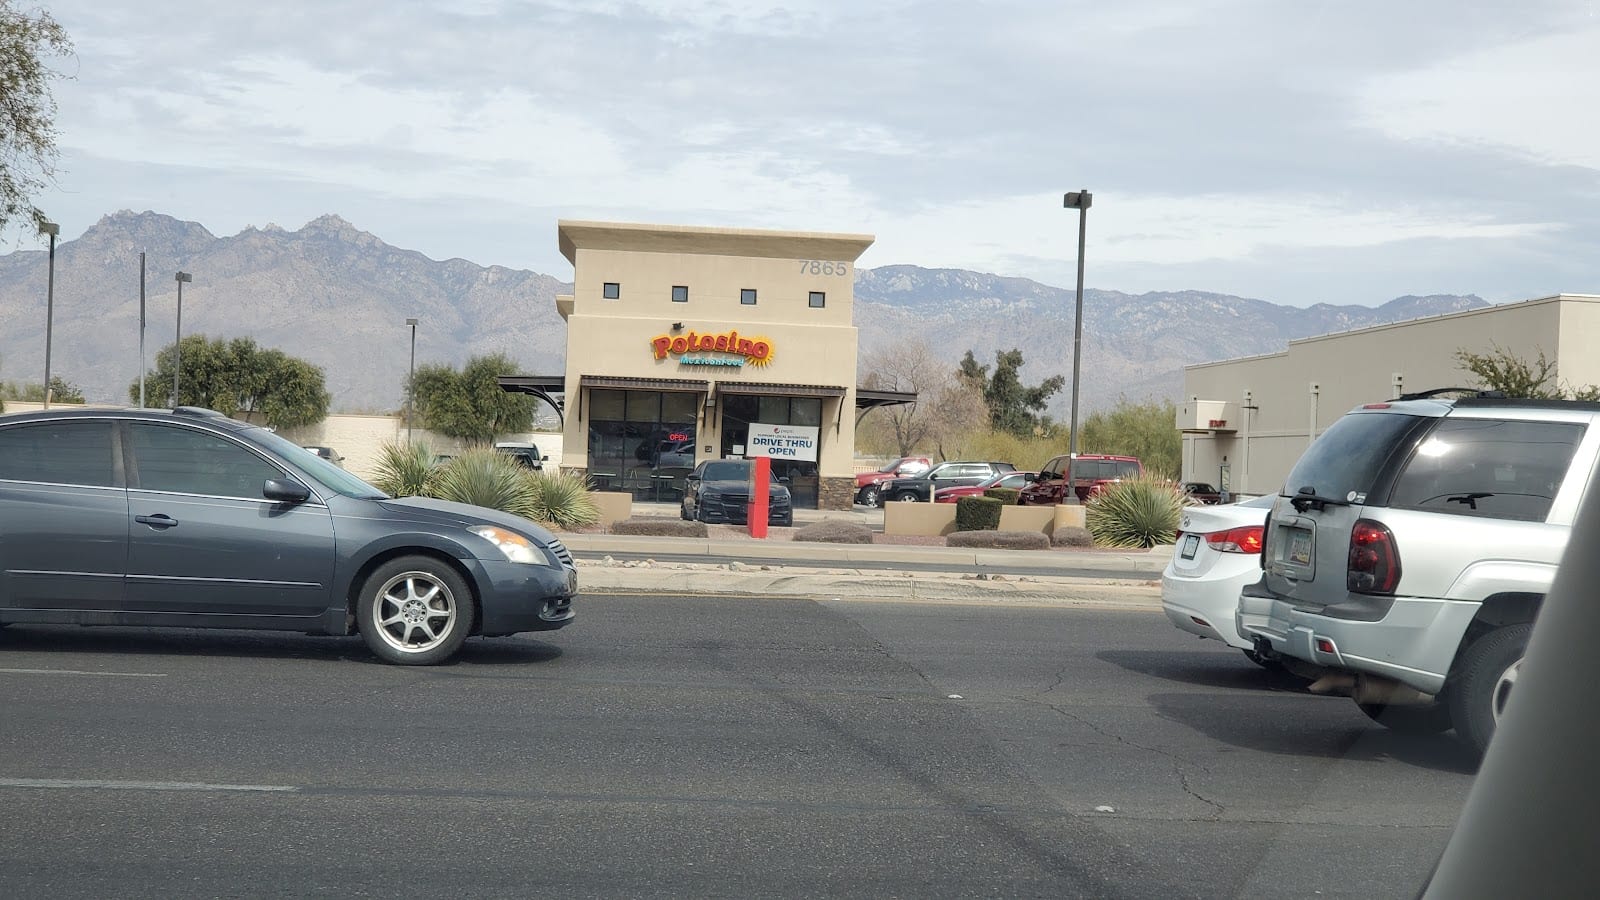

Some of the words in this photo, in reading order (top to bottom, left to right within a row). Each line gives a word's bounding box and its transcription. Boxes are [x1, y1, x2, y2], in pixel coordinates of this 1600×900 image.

[800, 260, 847, 276] 7865
[653, 331, 770, 360] Potosino
[669, 433, 688, 441] OPEN
[753, 438, 783, 446] DRIVE
[785, 440, 812, 448] THRU
[768, 447, 796, 456] OPEN
